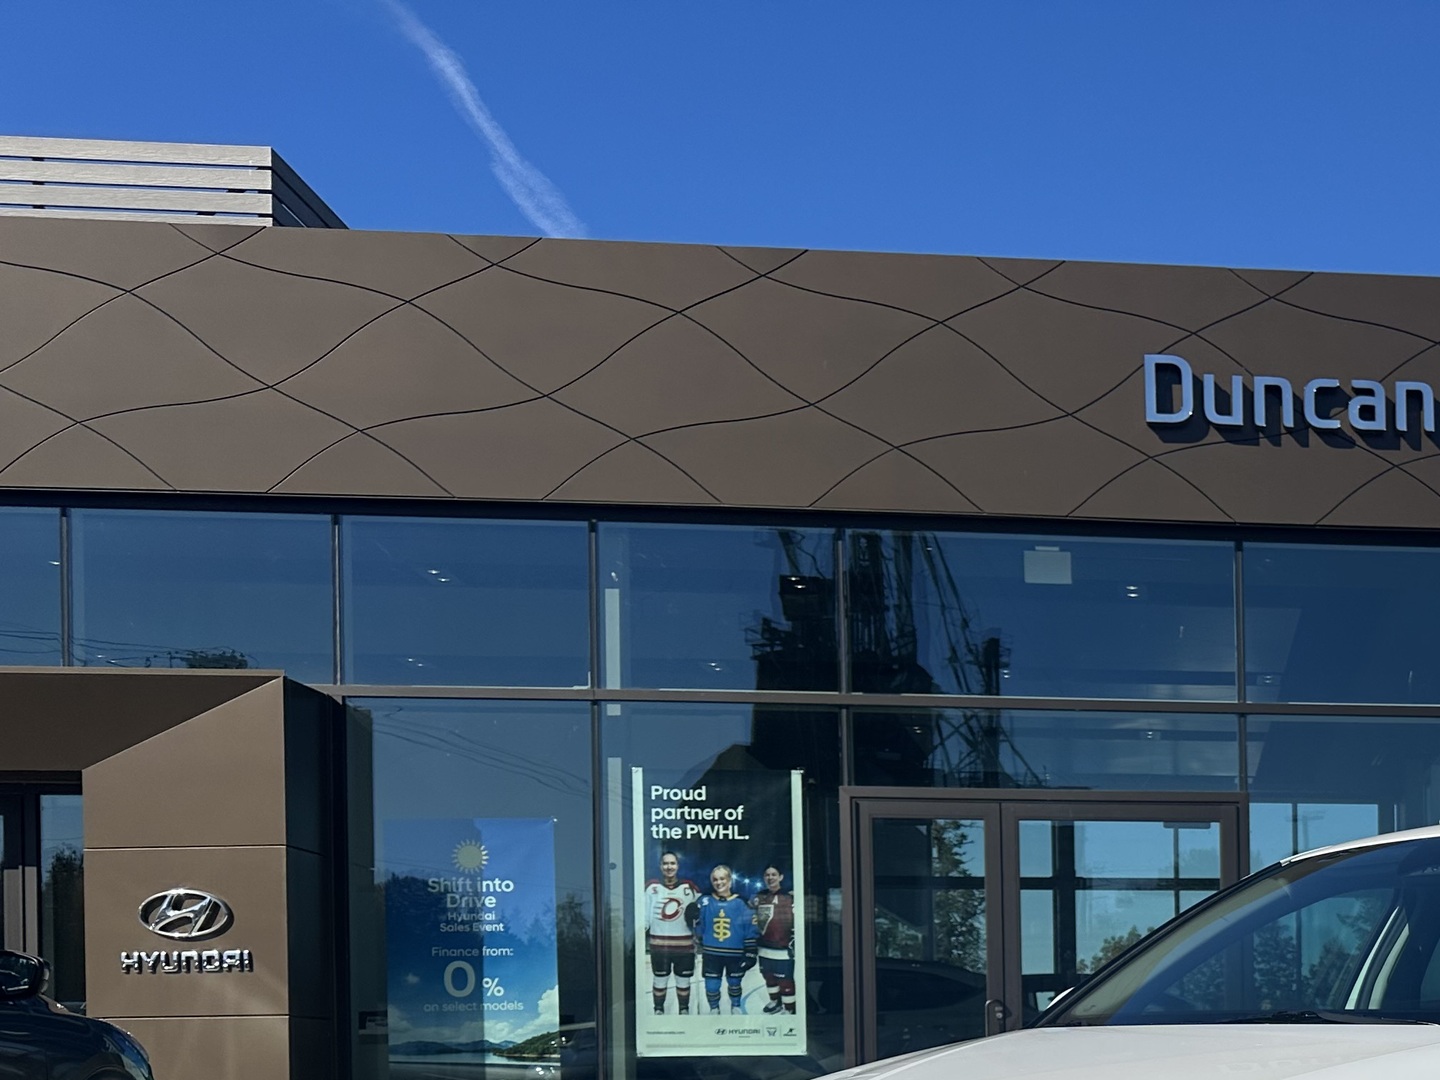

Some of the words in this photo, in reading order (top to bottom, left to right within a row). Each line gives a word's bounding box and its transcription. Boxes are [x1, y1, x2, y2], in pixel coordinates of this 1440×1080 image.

[1144, 353, 1436, 432] Duncan
[651, 785, 706, 801] Proud
[651, 806, 722, 822] partner
[724, 805, 744, 820] of
[650, 824, 682, 839] the
[686, 825, 750, 840] PWHL.
[427, 877, 473, 893] Shift
[476, 877, 515, 893] into
[446, 893, 497, 908] Drive
[448, 911, 496, 923] Hyundai
[440, 922, 471, 933] Sales
[472, 922, 504, 933] Event
[431, 946, 479, 957] Finance
[482, 945, 514, 957] from:
[120, 950, 254, 974] HYUNDAI
[423, 1003, 440, 1013] on
[442, 1001, 478, 1012] select
[479, 1000, 524, 1011] models
